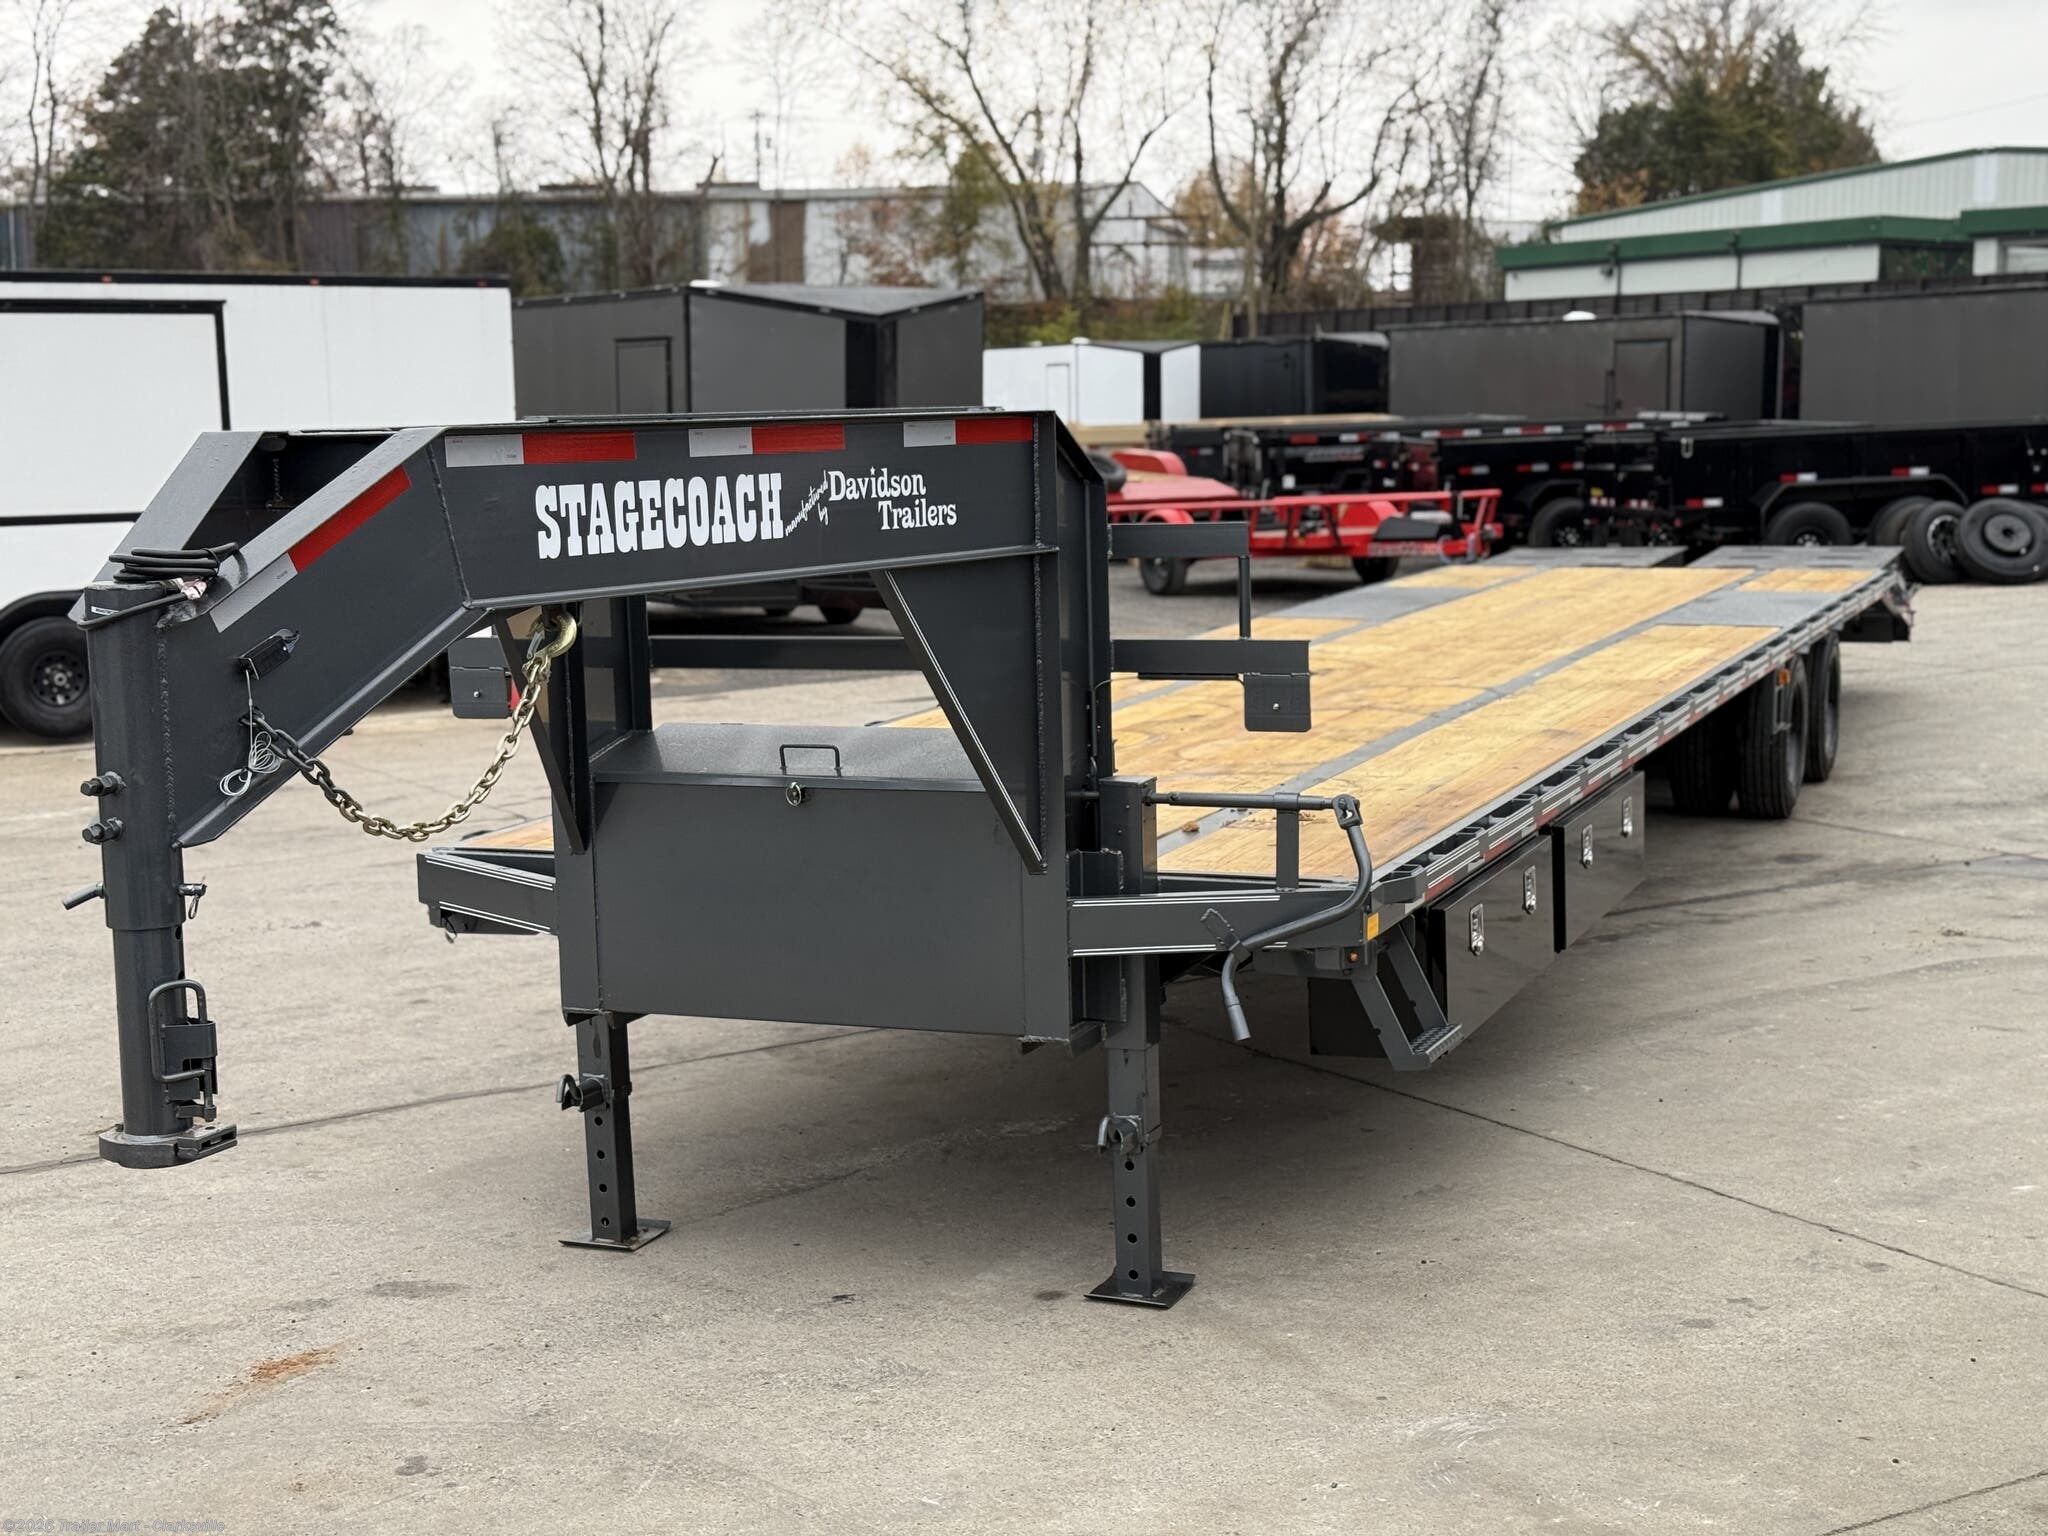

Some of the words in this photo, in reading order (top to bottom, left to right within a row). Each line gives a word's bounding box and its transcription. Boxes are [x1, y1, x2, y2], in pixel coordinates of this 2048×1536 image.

[785, 470, 828, 536] manufactured
[817, 502, 829, 526] by
[828, 466, 927, 501] Davidson
[535, 472, 784, 559] STAGECOACH
[878, 498, 957, 530] Trailers
